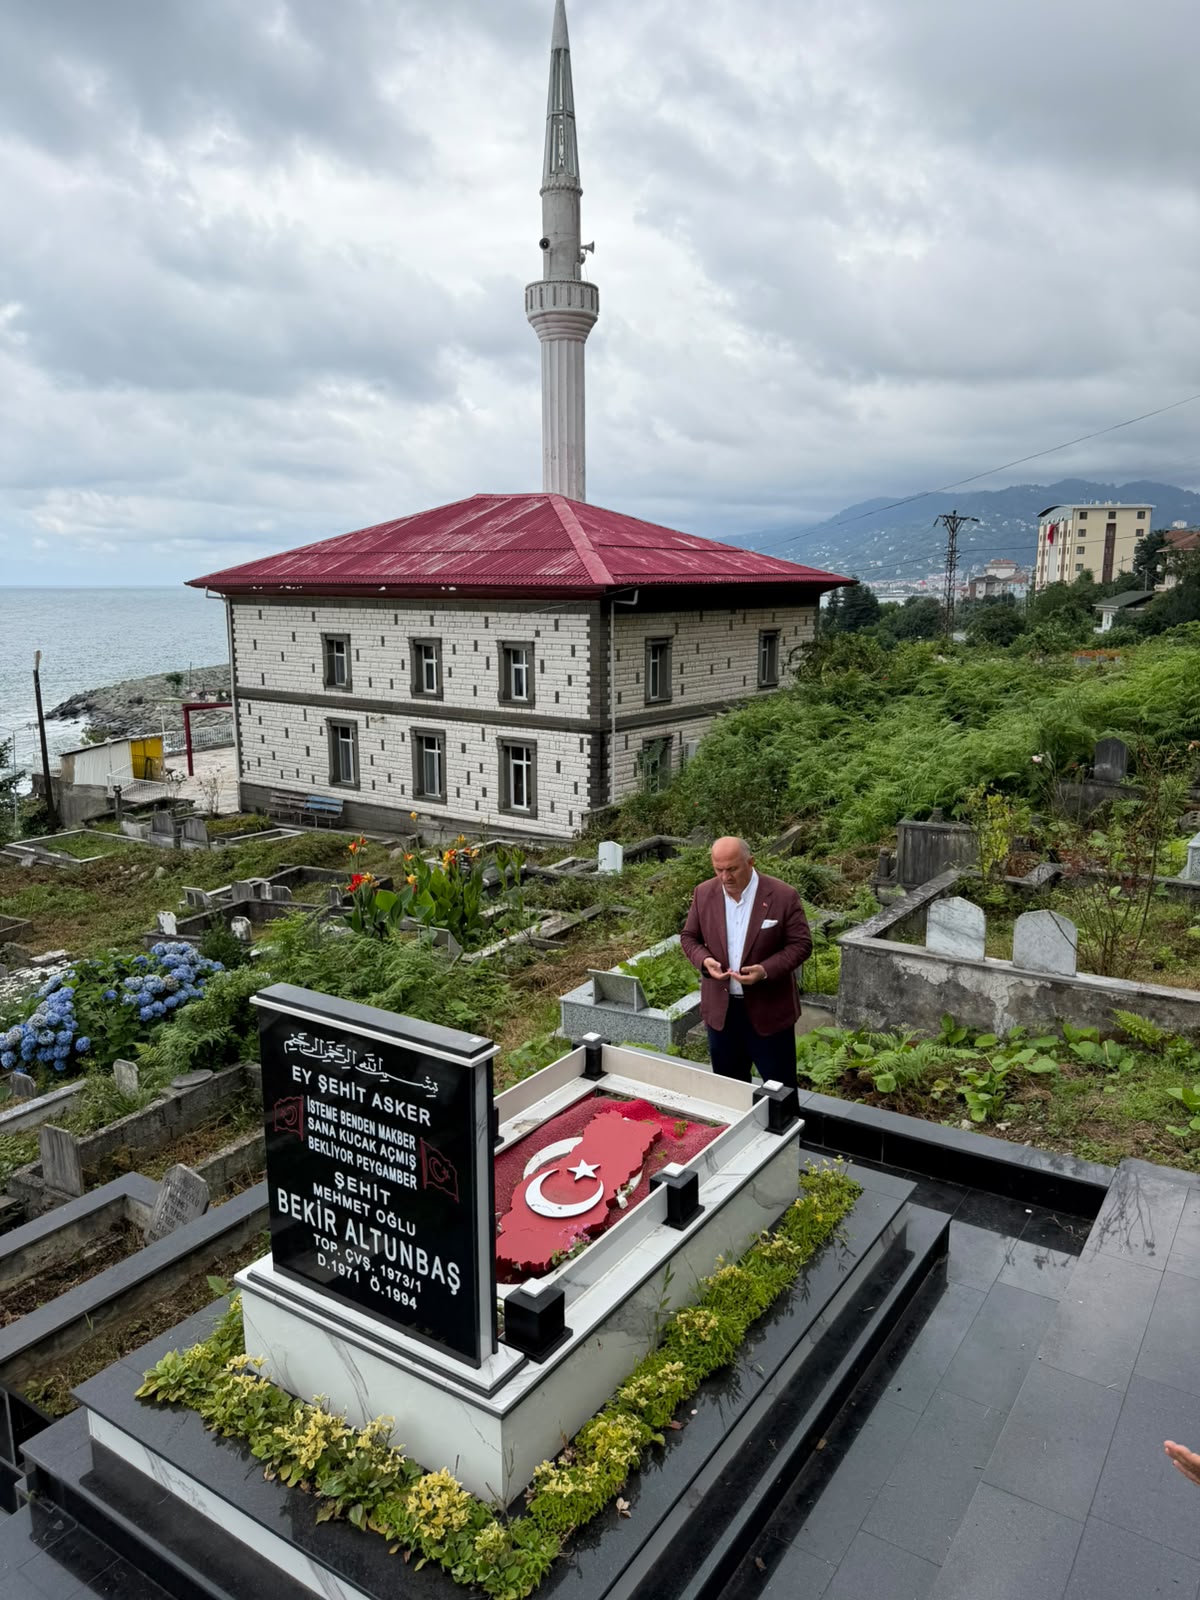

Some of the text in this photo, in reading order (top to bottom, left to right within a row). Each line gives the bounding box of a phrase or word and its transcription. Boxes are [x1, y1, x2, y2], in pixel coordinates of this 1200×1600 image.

[292, 1065, 432, 1127] EY ŞEHİT ASKER
[307, 1095, 417, 1152] İSTEME BENDEN MAKBER
[307, 1116, 417, 1172] SANA KUCAK AÇMIŞ
[308, 1135, 418, 1191] BEKLİYOR PEYGAMBER
[313, 1182, 416, 1237] MEHMET OĞLU
[334, 1171, 392, 1206] ŞEHİT
[277, 1187, 462, 1296] BEKİR ALTUNBAŞ
[313, 1233, 422, 1294] TOP. ÇVŞ. 1973/1
[317, 1252, 418, 1311] D.1971 Ö.1994
